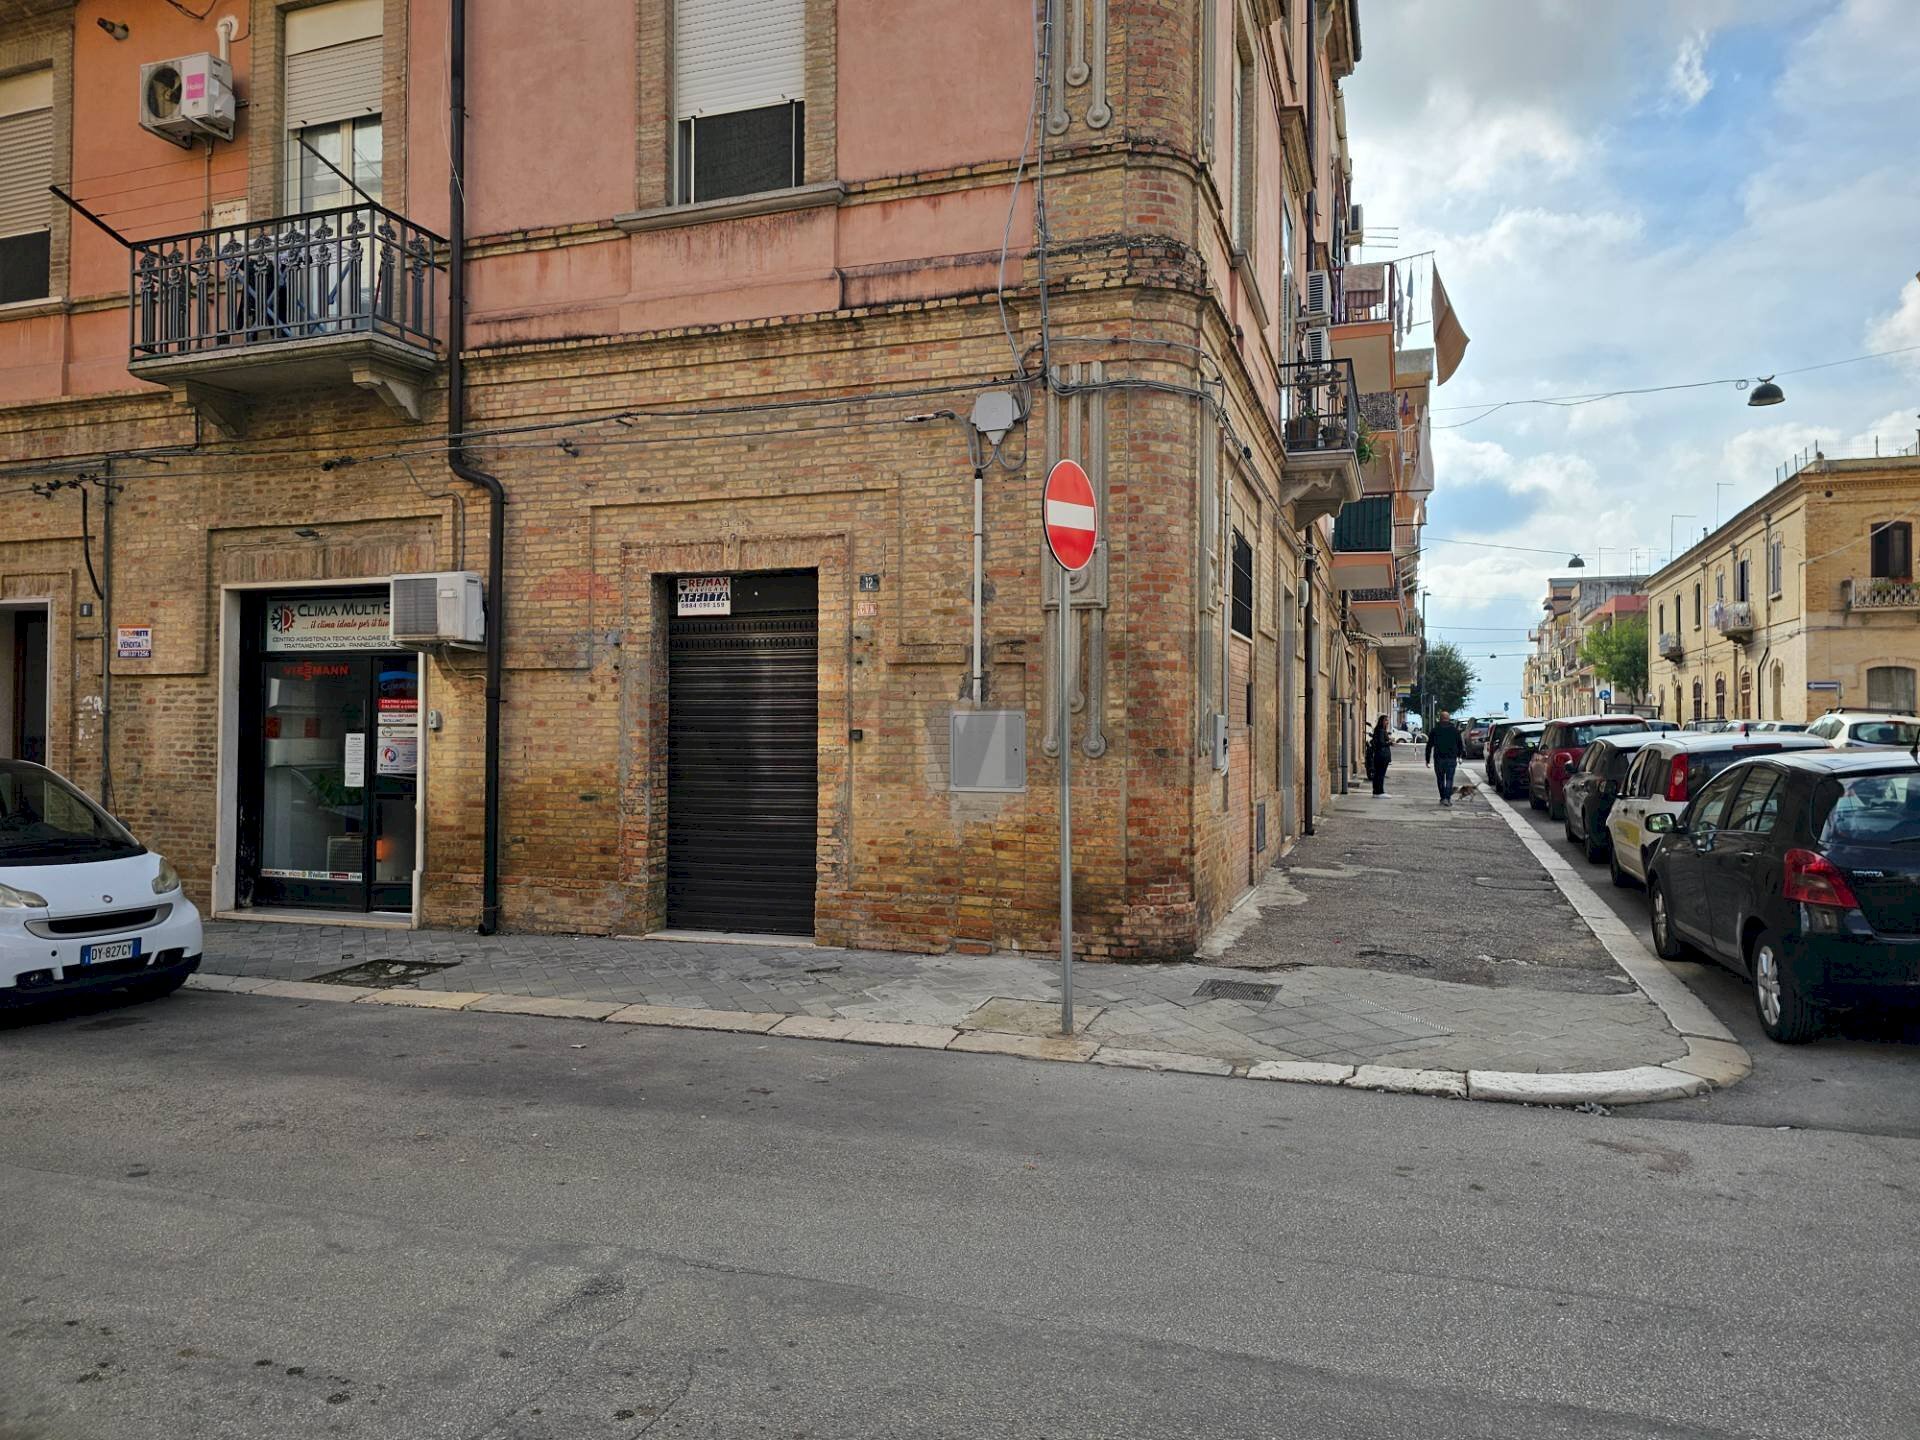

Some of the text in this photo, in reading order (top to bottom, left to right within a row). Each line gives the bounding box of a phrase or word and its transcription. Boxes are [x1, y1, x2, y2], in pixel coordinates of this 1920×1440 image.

[688, 577, 729, 587] RE/MAX
[865, 577, 873, 589] 12
[680, 592, 728, 602] AFFITTA
[297, 604, 338, 617] CLIMA
[341, 602, 380, 616] MULTI
[336, 619, 357, 629] ideale
[357, 621, 370, 631] per
[1852, 870, 1884, 878] TOYOTA
